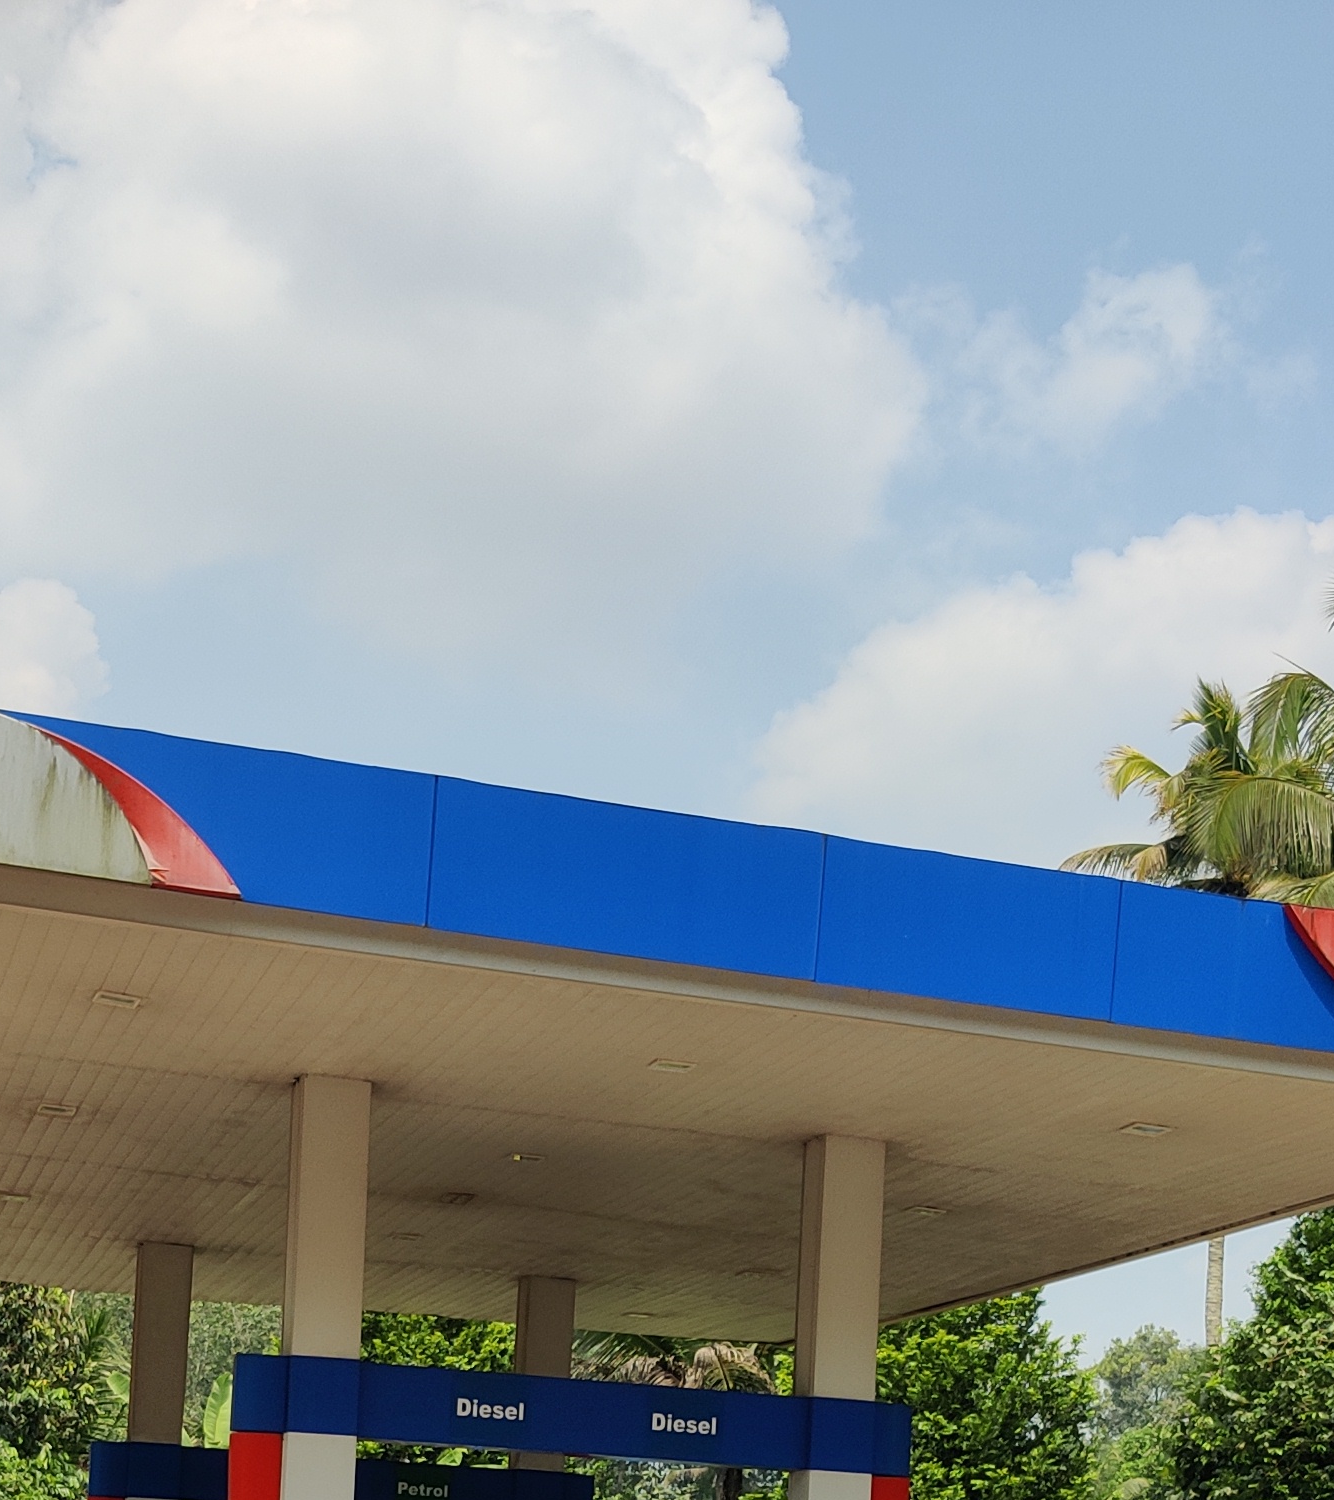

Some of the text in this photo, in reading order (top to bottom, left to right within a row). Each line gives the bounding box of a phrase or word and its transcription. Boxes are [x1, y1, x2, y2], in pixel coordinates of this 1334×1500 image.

[456, 1398, 717, 1436] Diesel Diesel
[397, 1481, 449, 1498] Petrol
